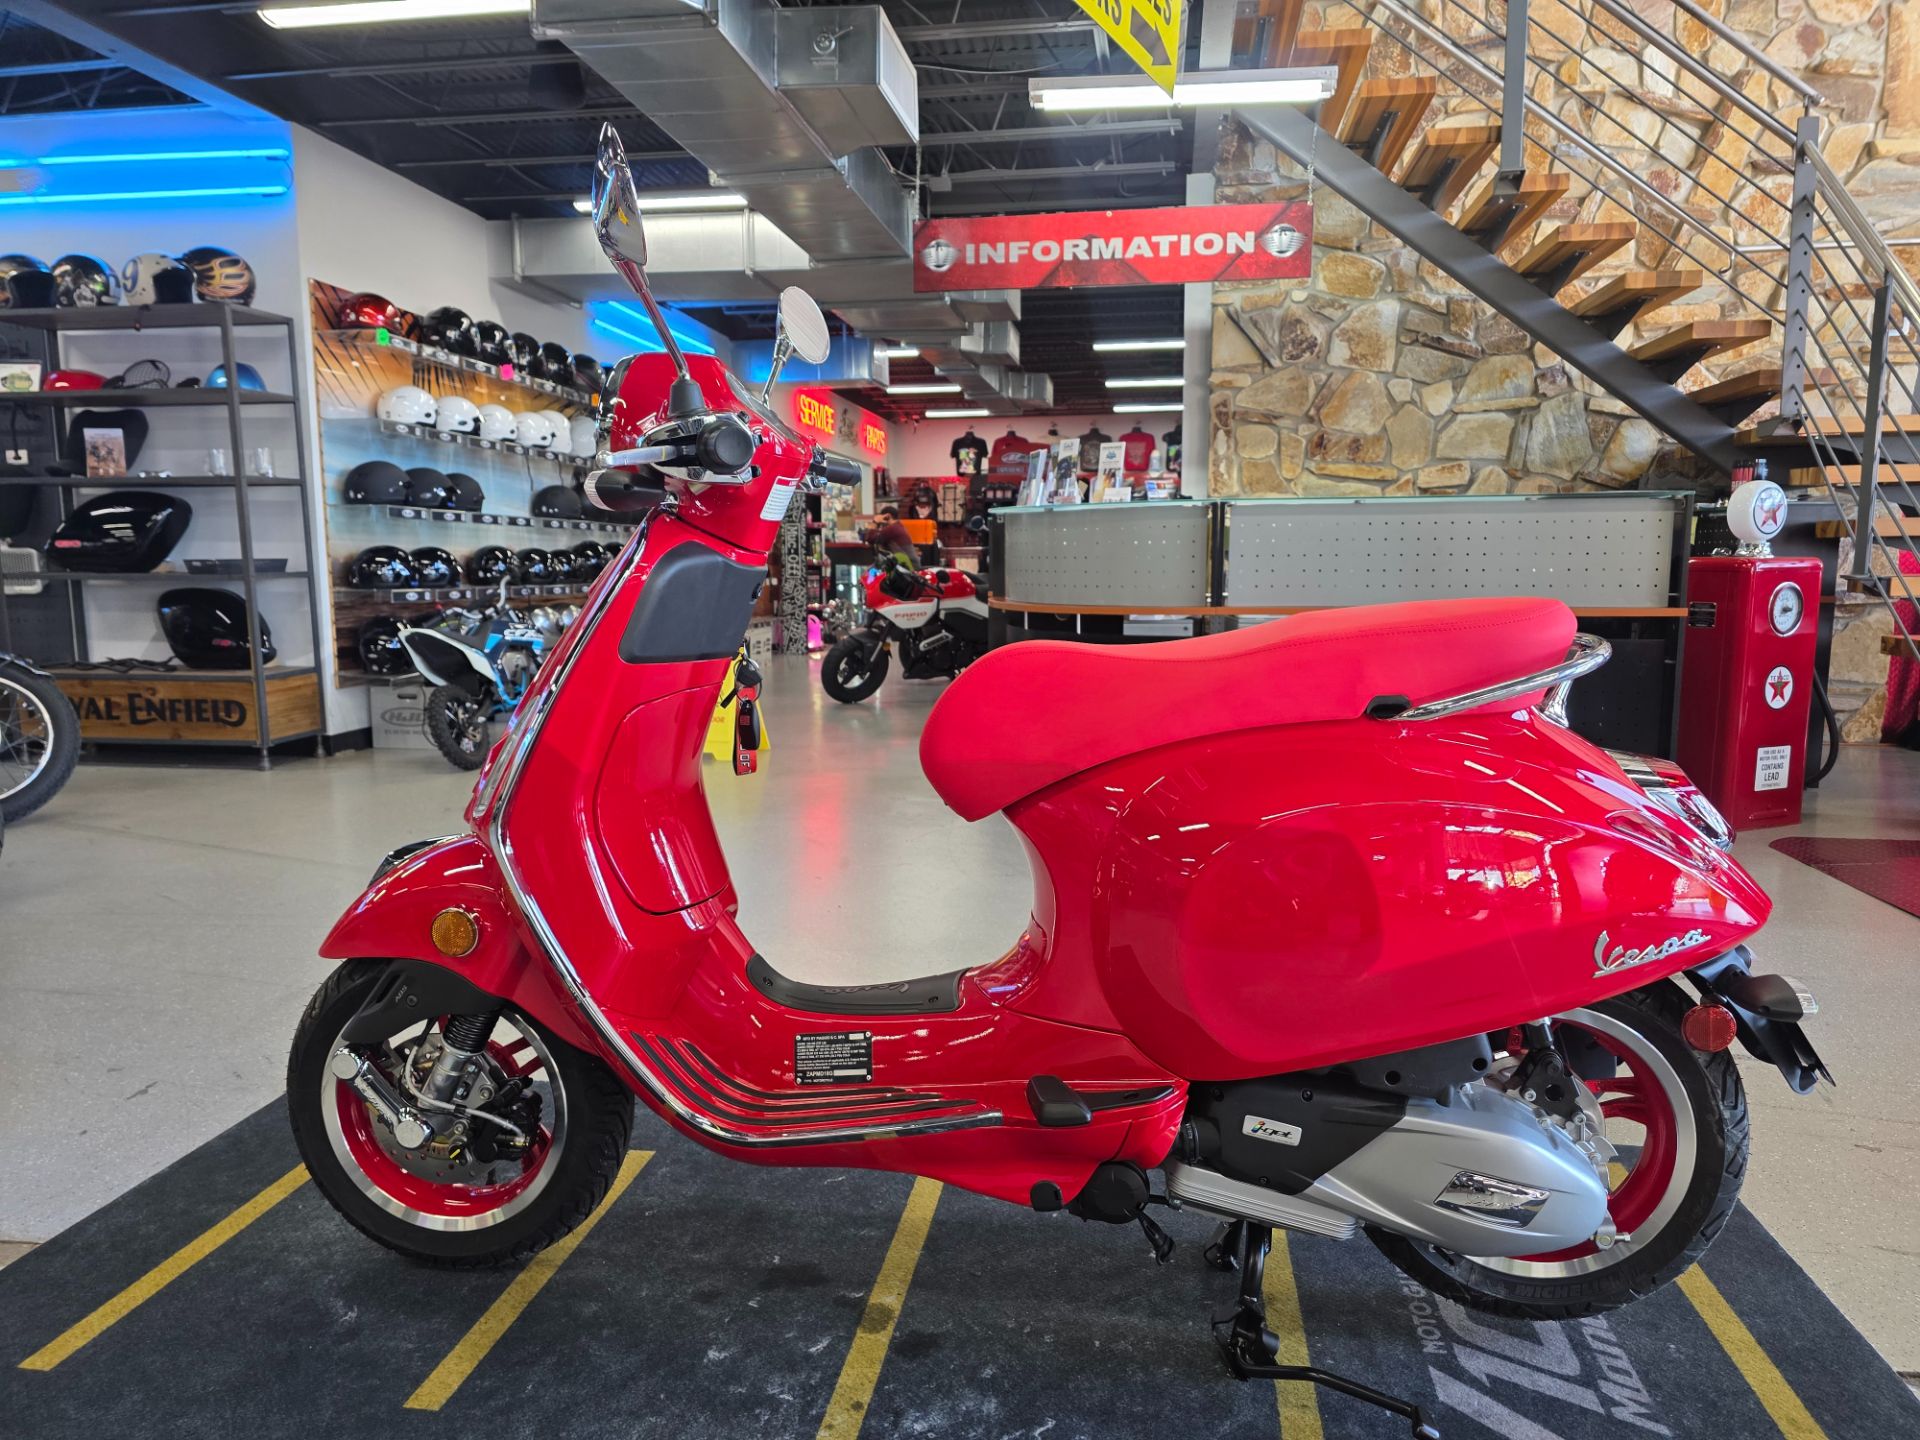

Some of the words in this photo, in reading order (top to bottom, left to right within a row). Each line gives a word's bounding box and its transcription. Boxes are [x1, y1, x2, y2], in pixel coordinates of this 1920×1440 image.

[965, 231, 1255, 265] INFORMATION
[800, 394, 835, 435] SERVICE
[866, 425, 885, 454] PARTS
[786, 525, 798, 576] Muc-Off
[67, 696, 121, 721] YAL
[128, 693, 247, 727] ENFIELD
[1761, 762, 1784, 771] CONTAINS
[1764, 772, 1780, 781] LEAD
[1592, 929, 1711, 979] Vespa
[1408, 1301, 1448, 1355] MOTO
